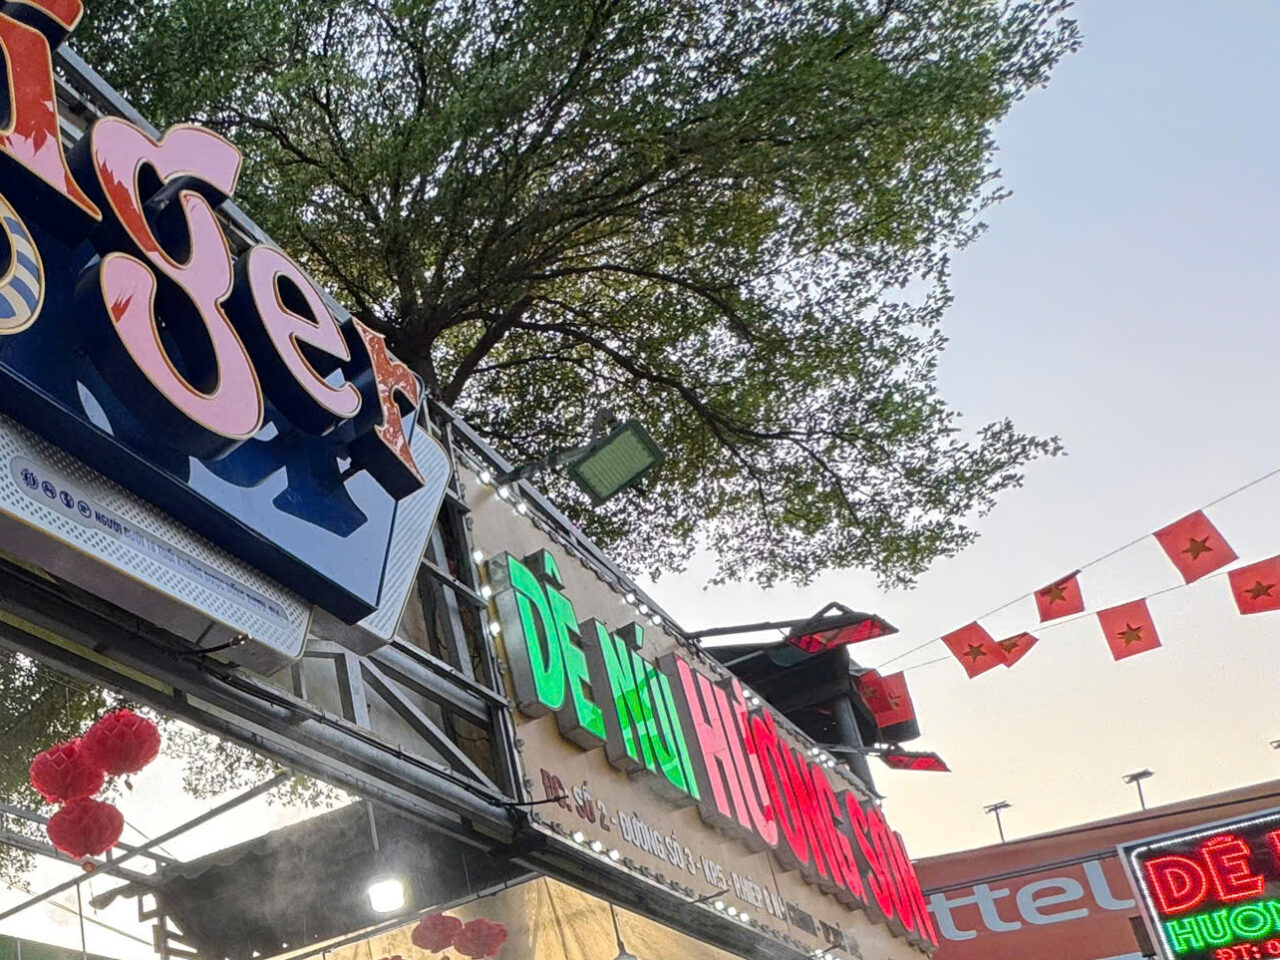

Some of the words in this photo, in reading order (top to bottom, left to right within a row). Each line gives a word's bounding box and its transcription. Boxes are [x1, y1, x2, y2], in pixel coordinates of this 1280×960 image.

[506, 549, 607, 741] DÊ
[594, 619, 701, 801] NÚI
[674, 653, 870, 906] HƯƠNG
[844, 790, 939, 947] SƠN
[596, 799, 611, 832] 2
[684, 847, 697, 876] 3
[1144, 834, 1265, 916] DÊ
